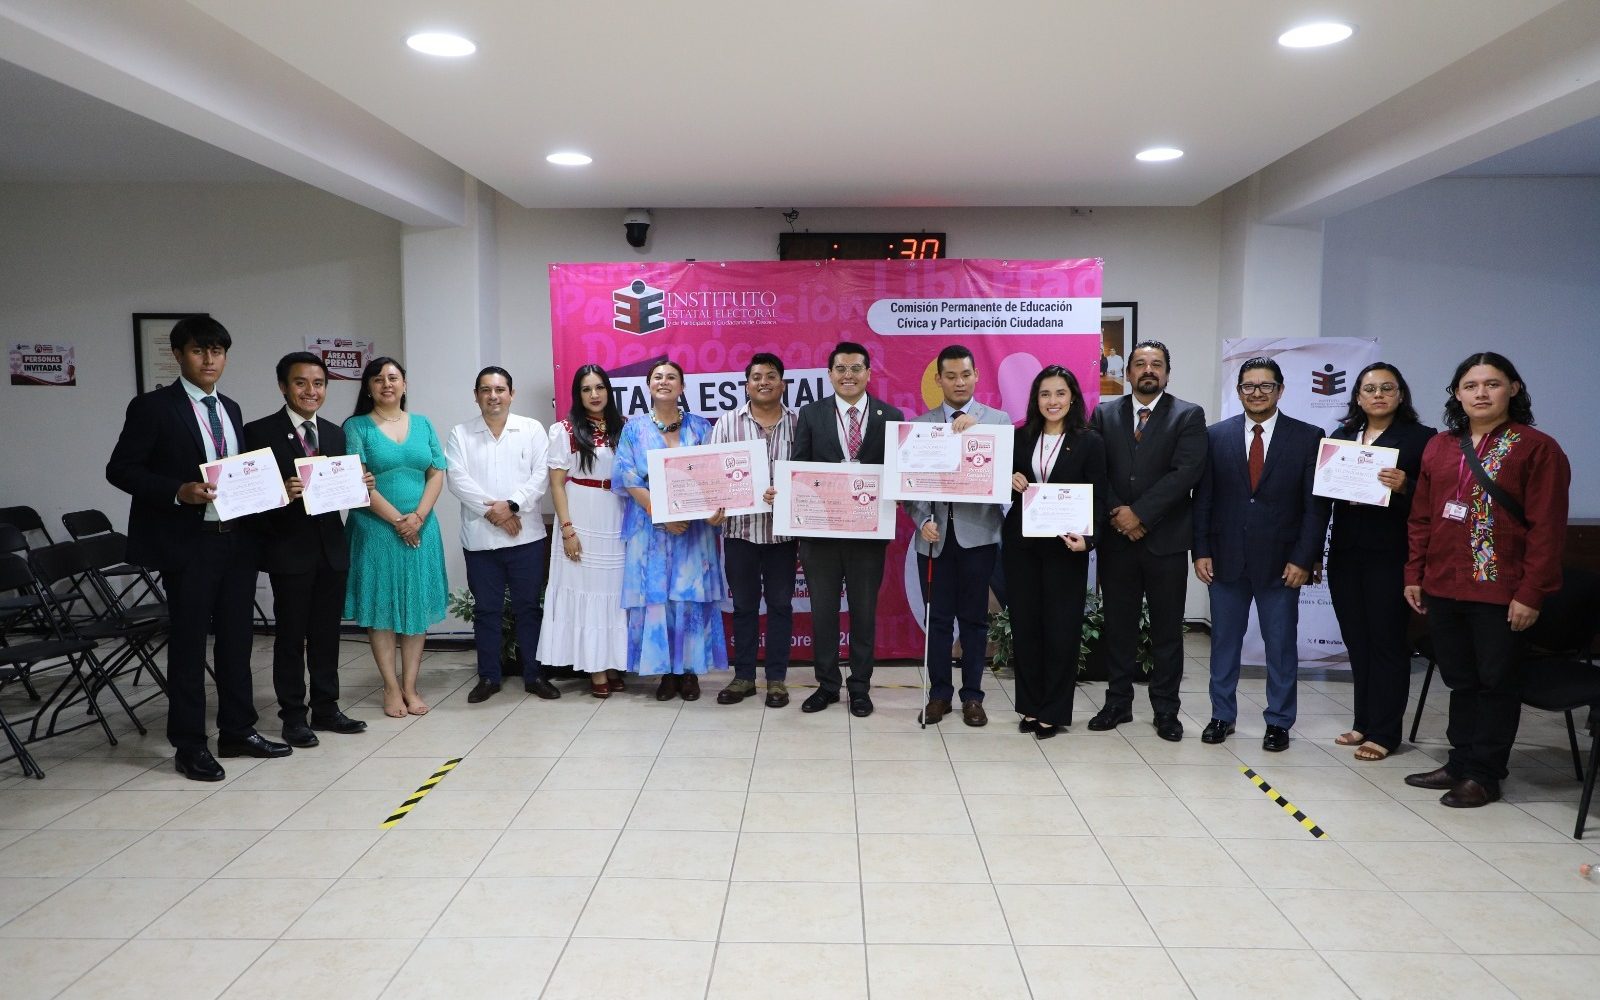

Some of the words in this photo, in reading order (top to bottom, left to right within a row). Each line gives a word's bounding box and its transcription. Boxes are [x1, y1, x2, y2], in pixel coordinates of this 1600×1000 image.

[667, 291, 777, 307] INSTITUTO
[890, 301, 939, 313] Comisión
[941, 301, 1002, 312] Permanente
[1004, 300, 1018, 312] de
[1020, 300, 1073, 312] Educación
[667, 309, 712, 319] ESTATAL
[715, 308, 778, 319] ELECTORAL
[897, 317, 929, 329] Cívica
[931, 319, 937, 331] y
[940, 316, 1007, 331] Participación
[1009, 316, 1064, 328] Ciudadana
[327, 351, 346, 359] ÁREA
[346, 352, 356, 360] DE
[23, 364, 62, 372] INVITADAS
[324, 359, 359, 367] PRENSA
